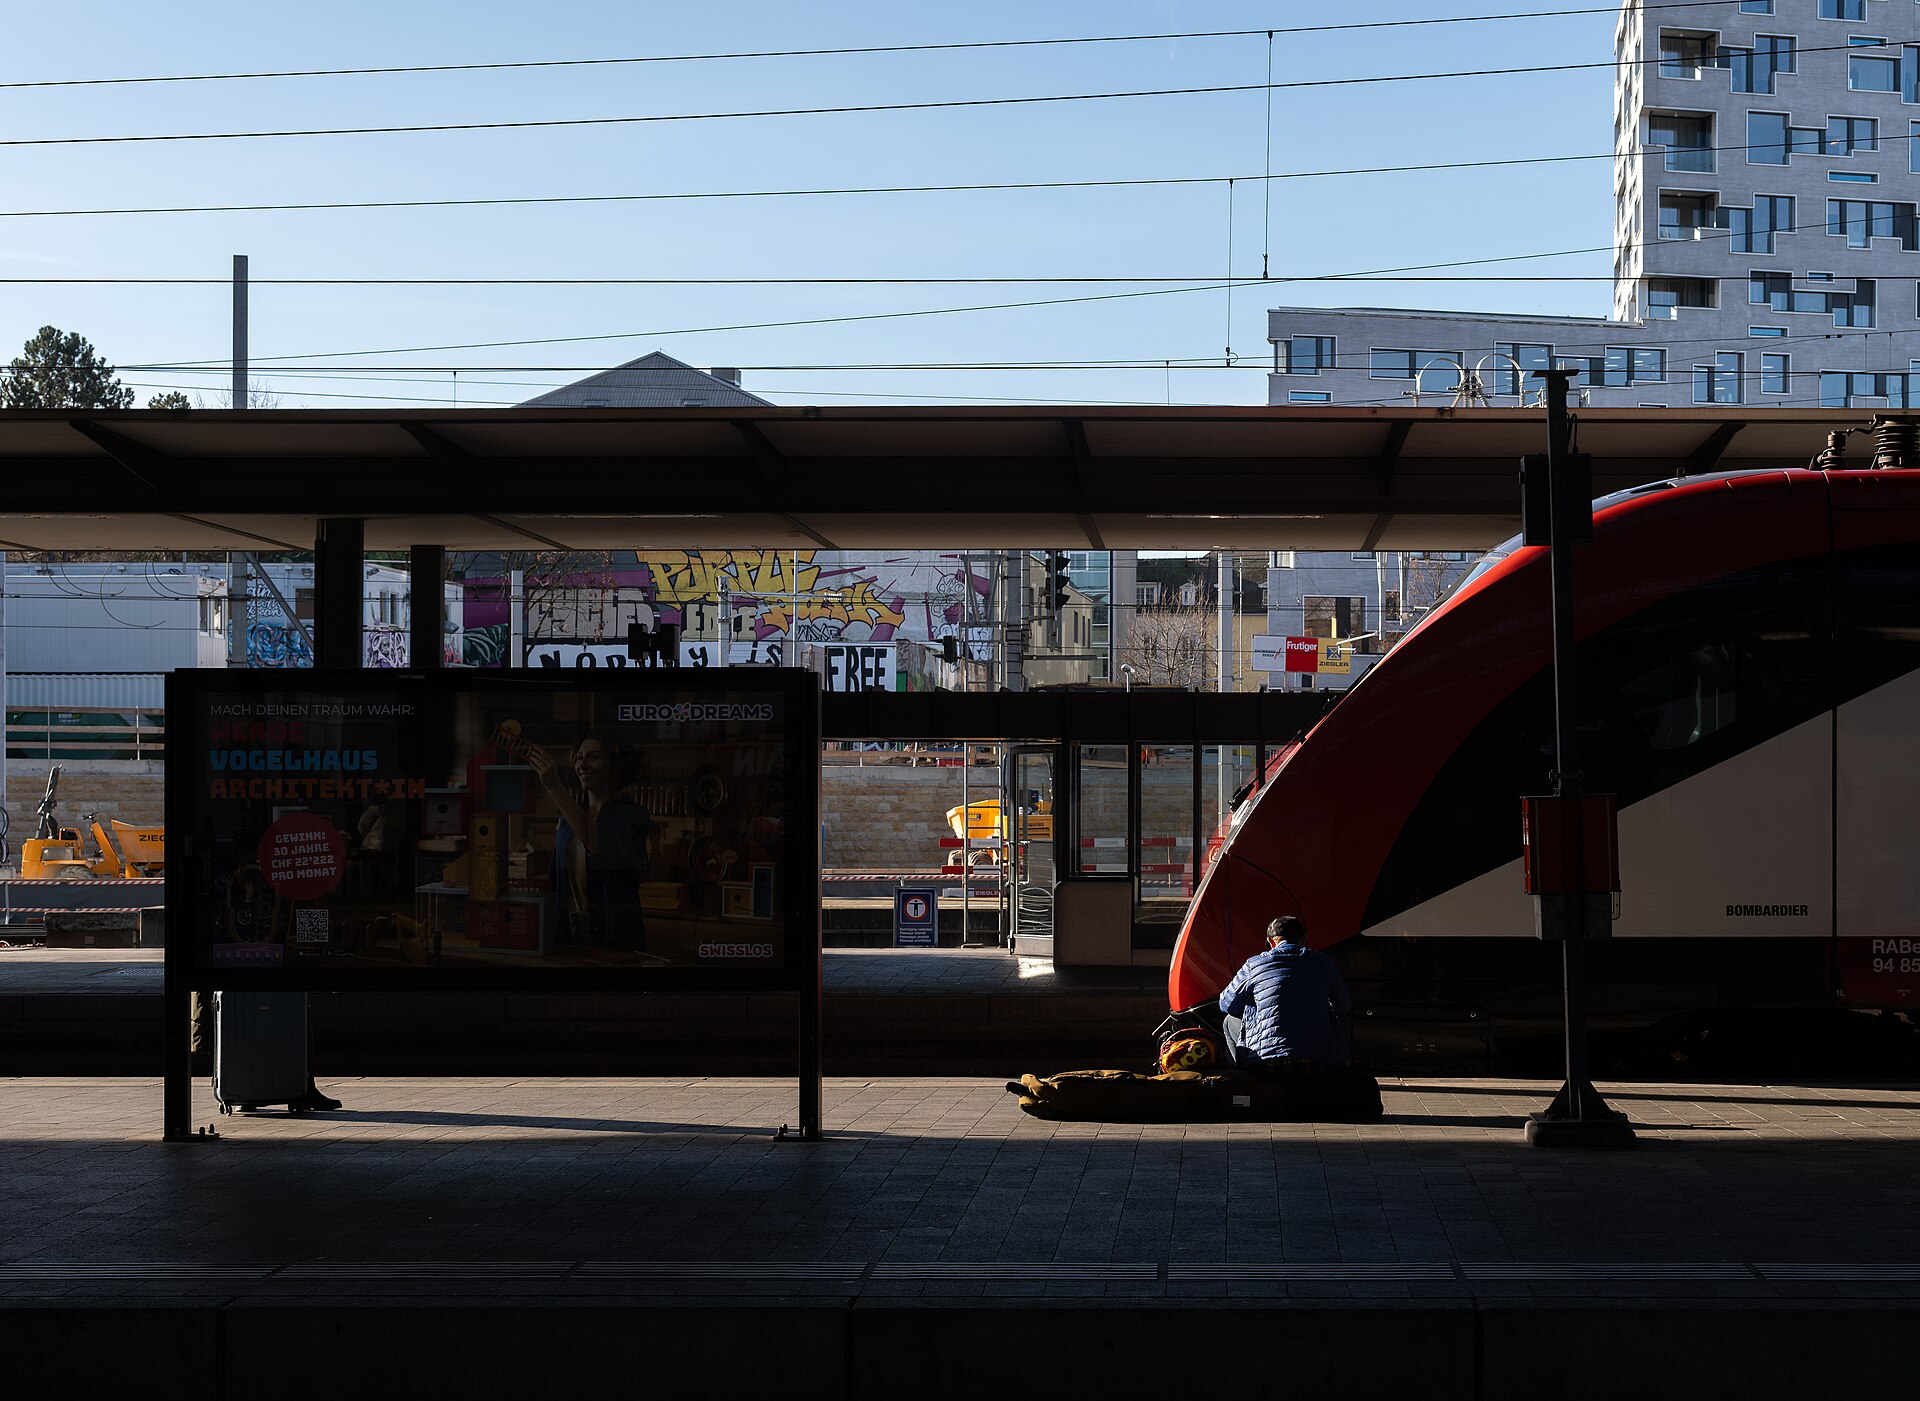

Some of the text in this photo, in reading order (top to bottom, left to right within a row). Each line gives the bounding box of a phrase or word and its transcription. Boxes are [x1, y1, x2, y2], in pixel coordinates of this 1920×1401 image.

[1287, 641, 1317, 652] Frutiger
[827, 646, 887, 692] FREE
[210, 704, 415, 716] MACH DEINEN TRAUM WAHR:
[619, 704, 773, 720] EURO DREAMS
[210, 721, 305, 743] WERDE
[210, 749, 378, 771] VOGELHAUS
[275, 831, 326, 844] GEWINN:
[273, 843, 330, 856] 30 JAHRE
[272, 855, 335, 869] CHF 22'222
[271, 867, 337, 881] PRO MONAT
[1726, 905, 1808, 916] BOMBARDIER
[699, 944, 773, 957] SWISSLOS
[1872, 939, 1920, 954] RABe
[1872, 958, 1920, 973] 94 85
